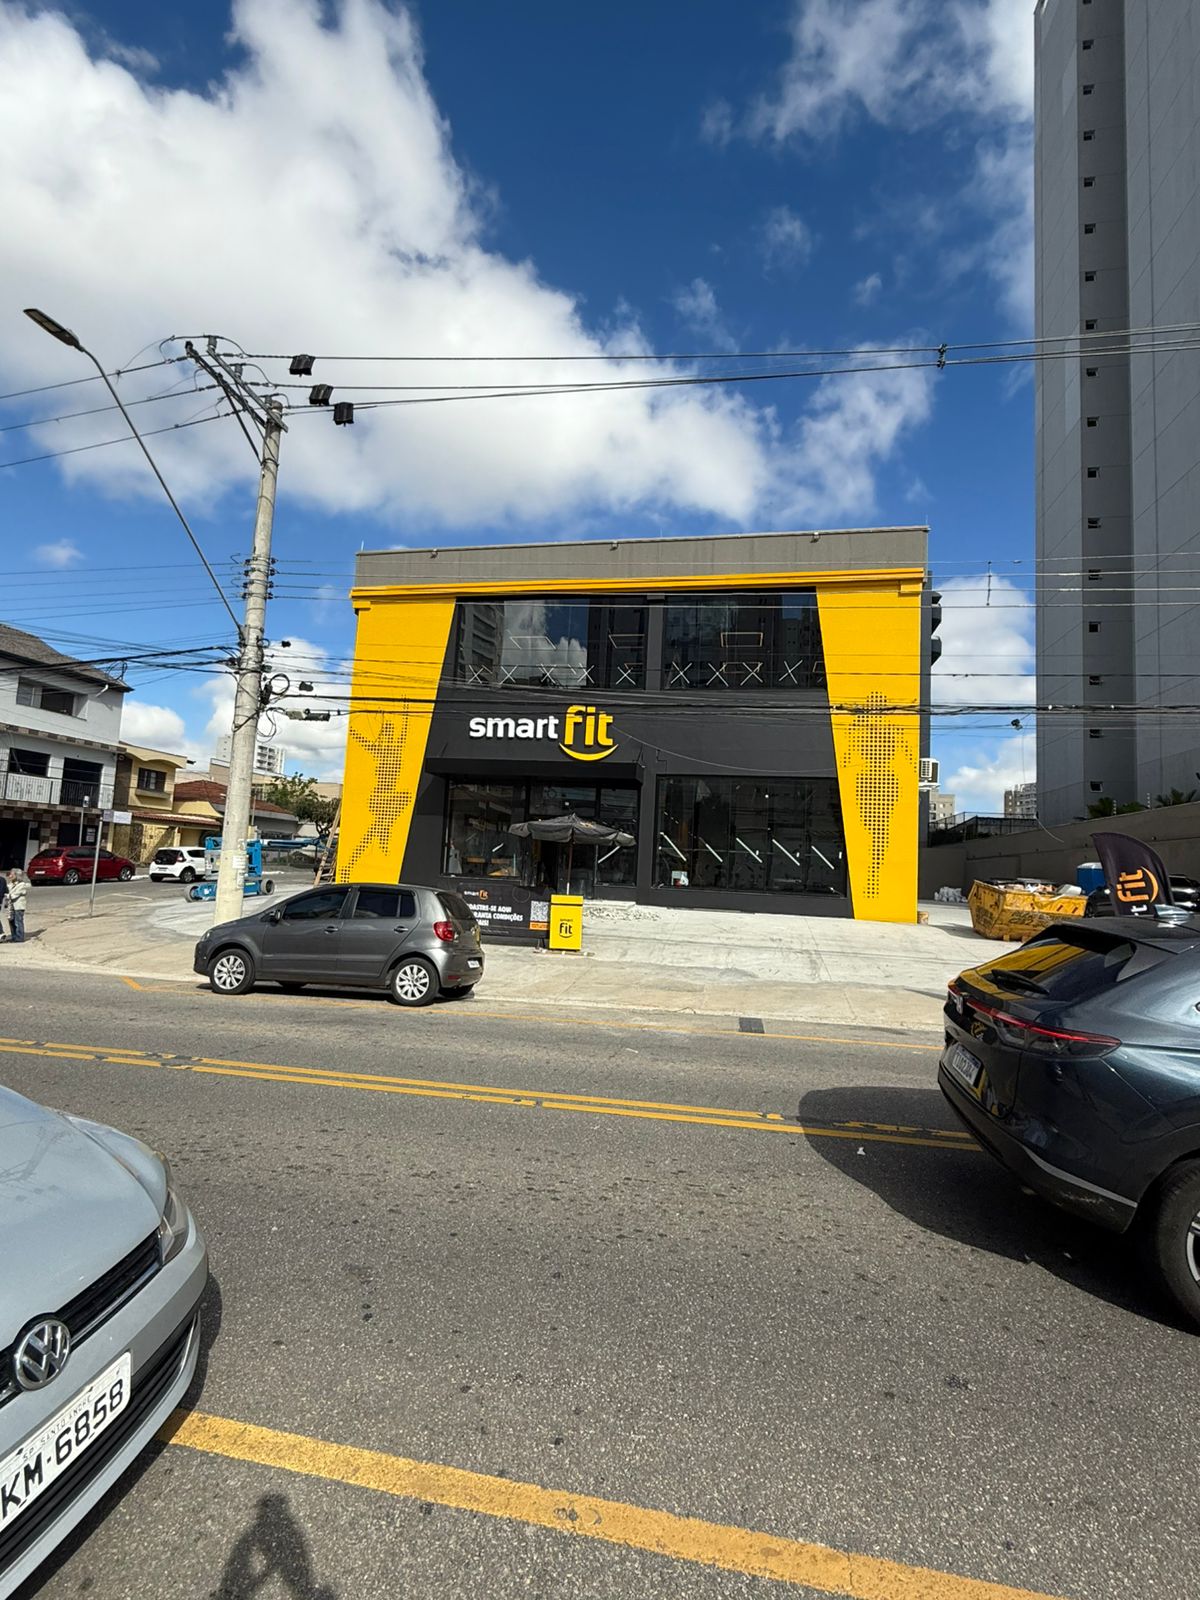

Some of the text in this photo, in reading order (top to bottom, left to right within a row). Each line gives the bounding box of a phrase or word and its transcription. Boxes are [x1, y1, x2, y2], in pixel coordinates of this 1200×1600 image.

[469, 704, 614, 746] smart fit
[1116, 869, 1150, 902] fit
[467, 903, 512, 913] DASTRE-SE AQUI
[473, 911, 523, 922] RANTA CONDIÇÕES
[559, 922, 573, 934] fit
[40, 1418, 66, 1447] SANTO
